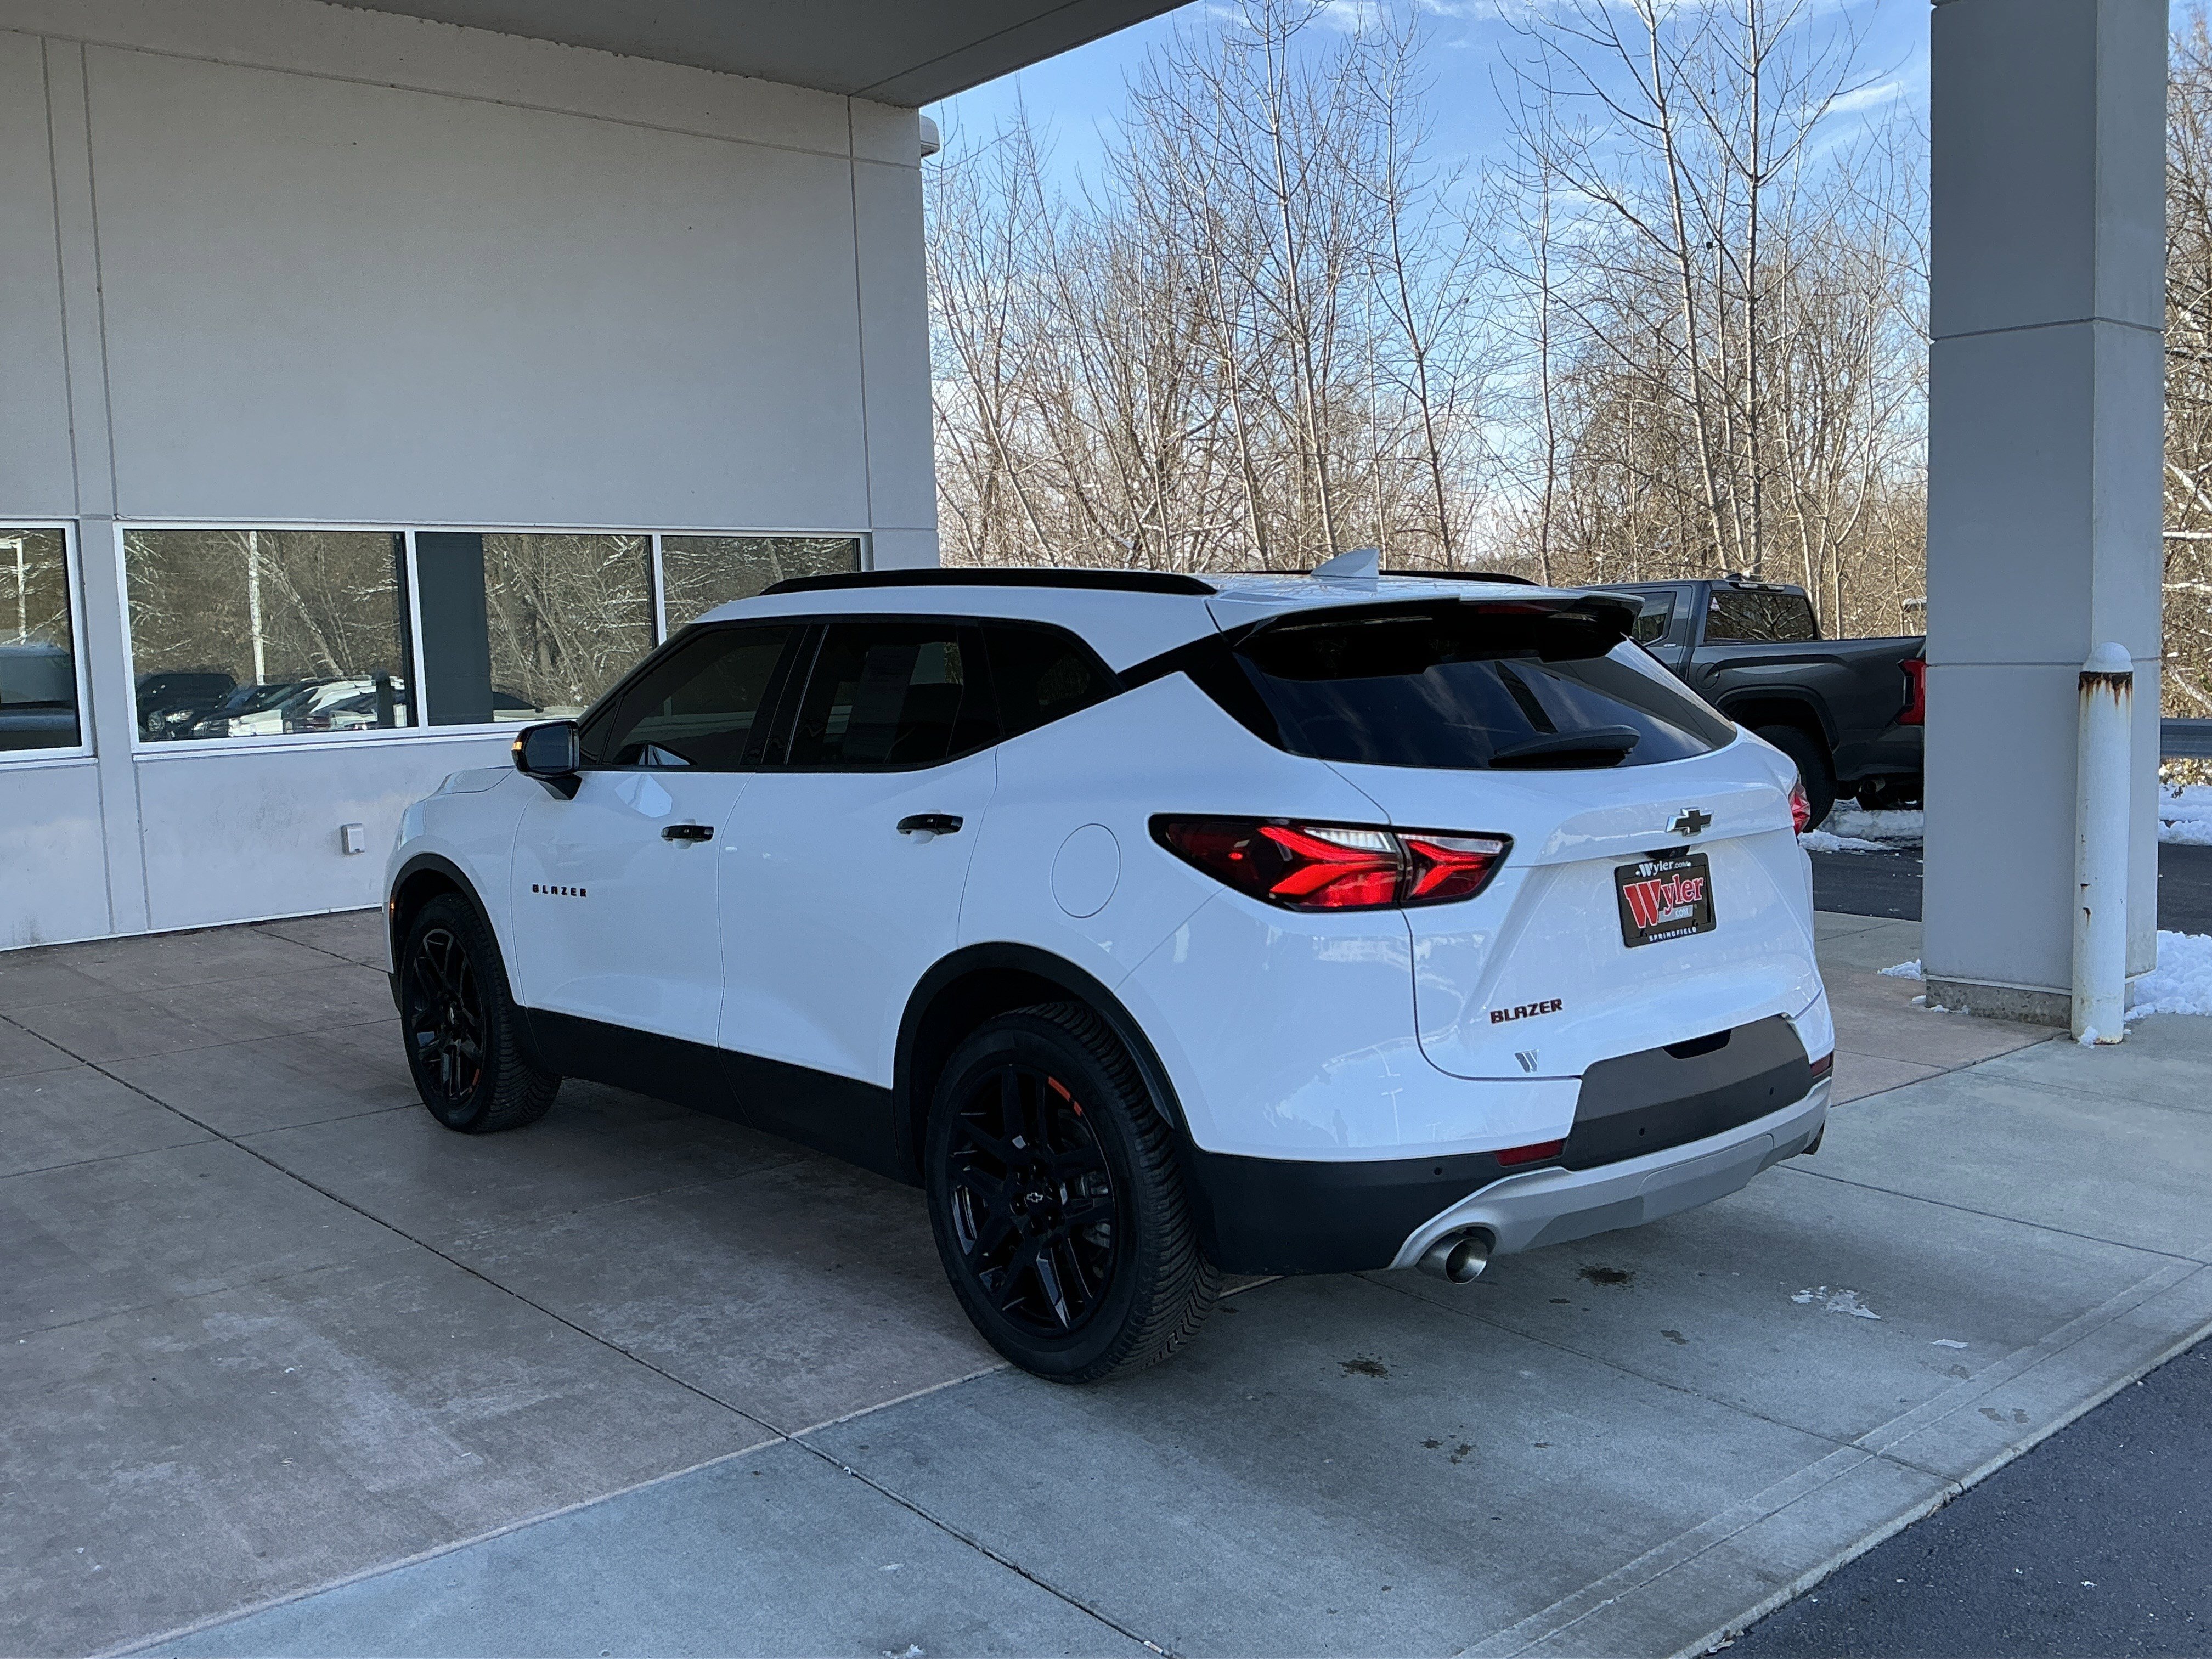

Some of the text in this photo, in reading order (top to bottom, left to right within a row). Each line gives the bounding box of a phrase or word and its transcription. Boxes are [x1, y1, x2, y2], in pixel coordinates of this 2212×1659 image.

[533, 884, 586, 897] BLAZER
[1623, 874, 1704, 928] Wyler
[1649, 927, 1697, 941] SPRINGFIELD
[1491, 998, 1563, 1024] BLAZER
